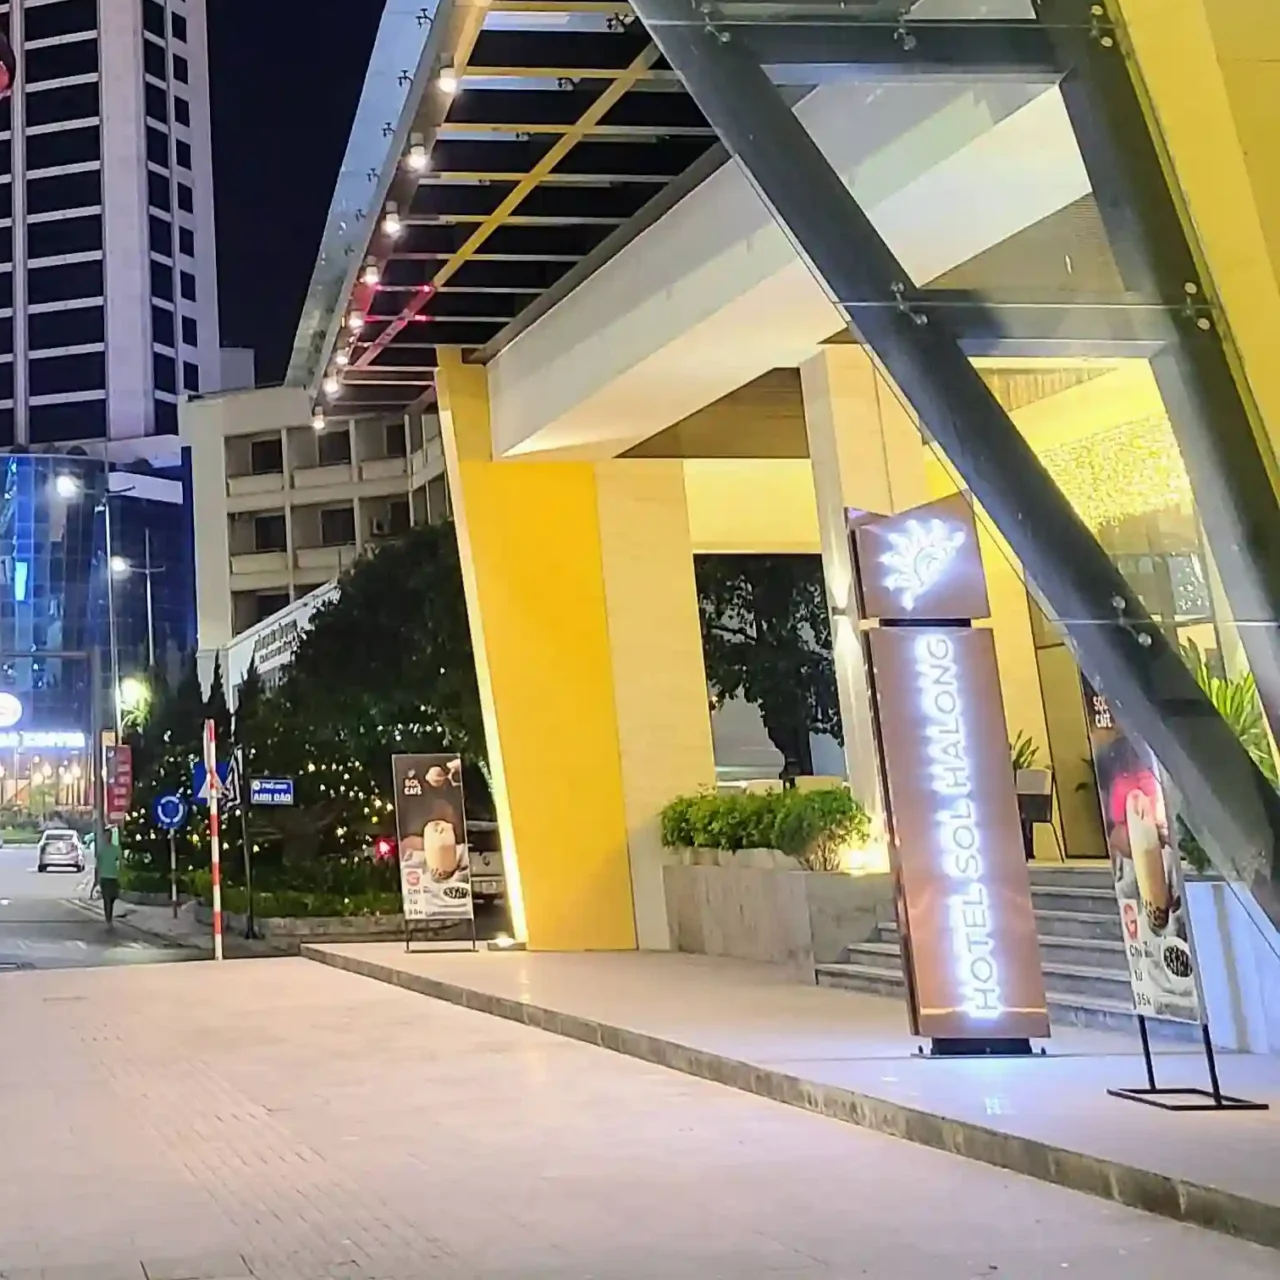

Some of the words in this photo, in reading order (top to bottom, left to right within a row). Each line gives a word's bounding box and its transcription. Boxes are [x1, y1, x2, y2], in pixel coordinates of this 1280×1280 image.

[924, 635, 970, 791] HALONG
[940, 800, 978, 876] SOL
[956, 884, 1000, 1014] HOTEL
